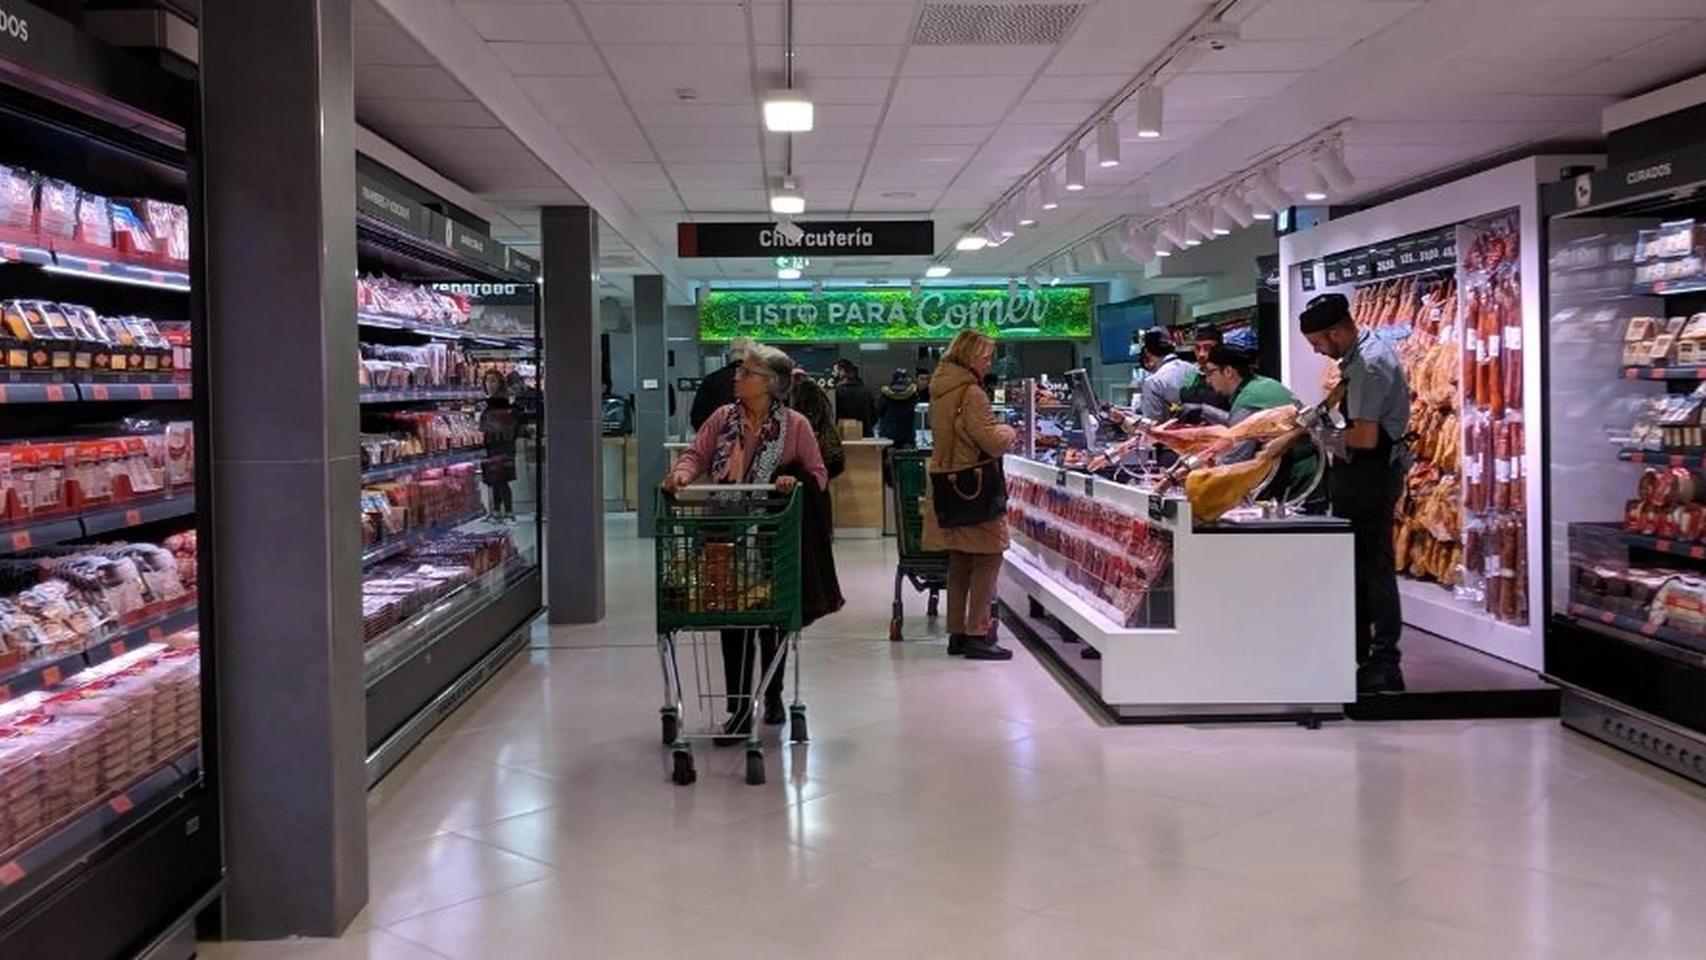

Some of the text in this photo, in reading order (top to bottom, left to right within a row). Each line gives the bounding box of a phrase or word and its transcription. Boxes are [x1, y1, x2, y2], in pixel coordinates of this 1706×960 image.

[739, 290, 1050, 330] LISTO PARA Comer
